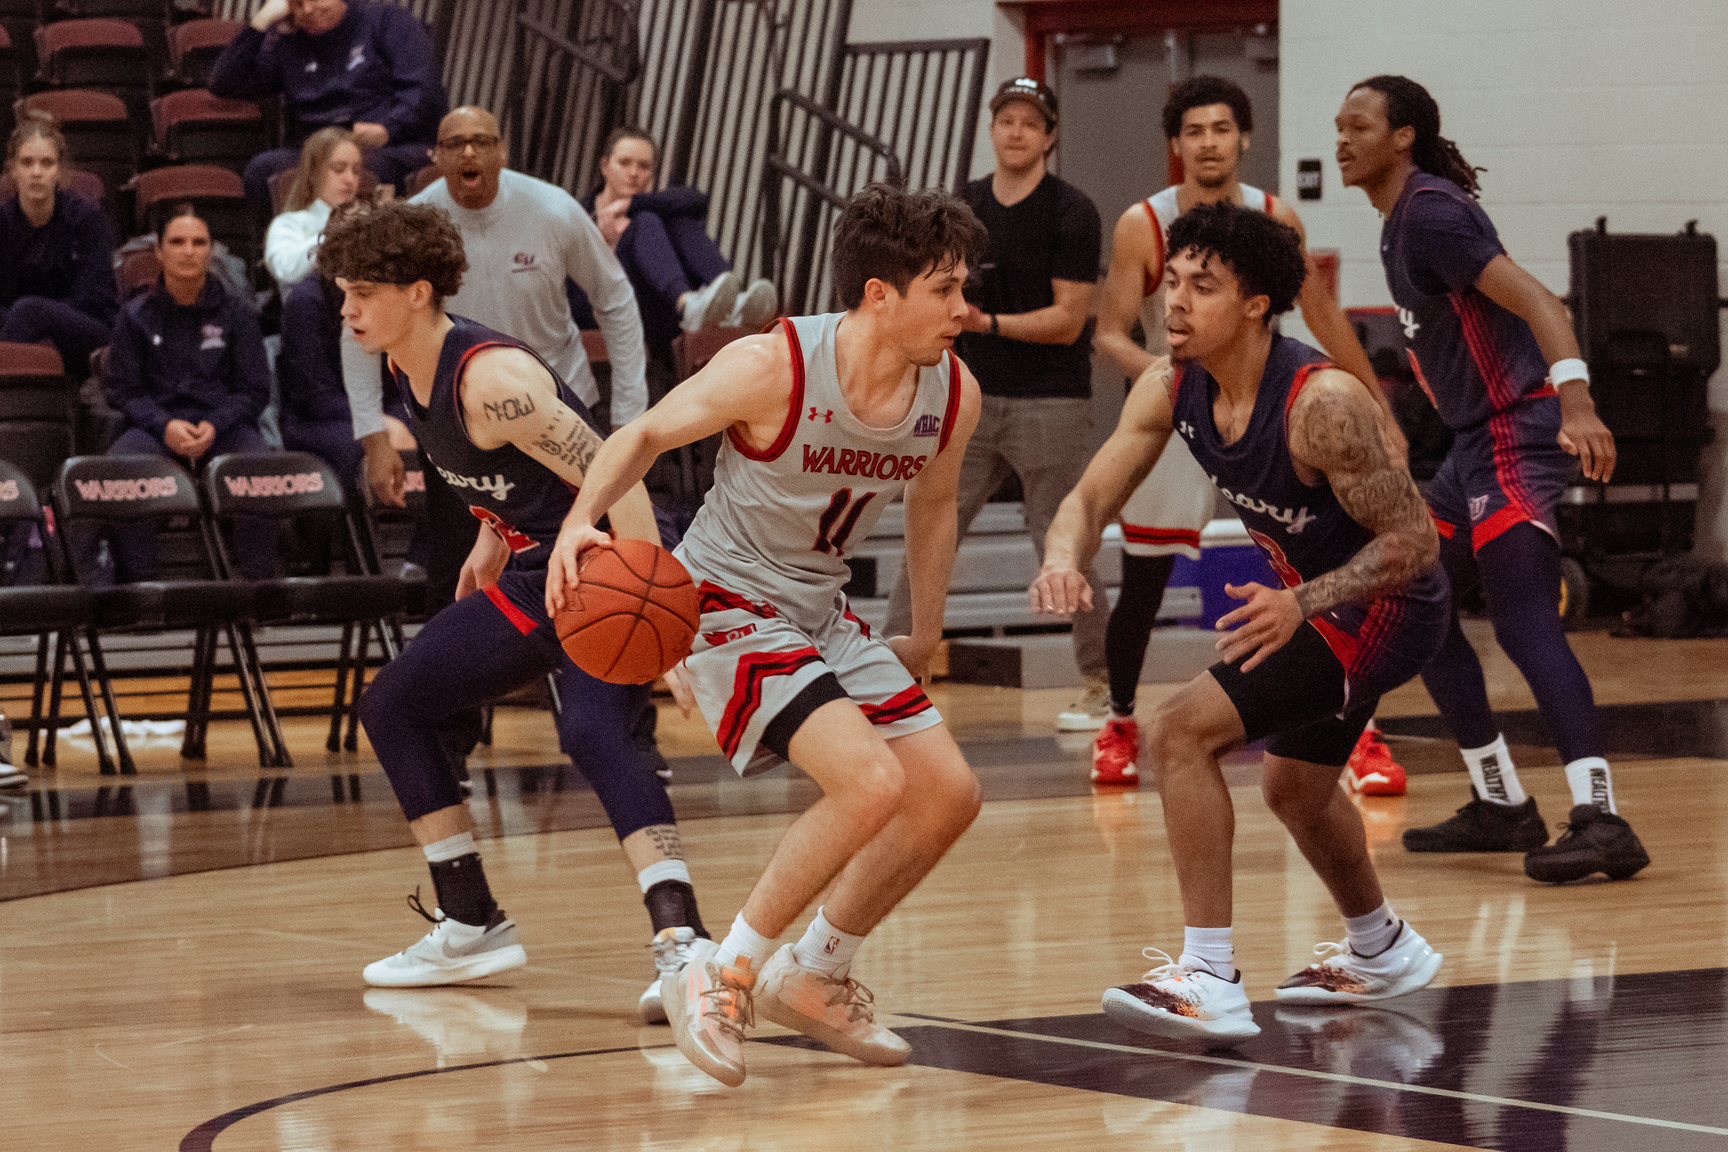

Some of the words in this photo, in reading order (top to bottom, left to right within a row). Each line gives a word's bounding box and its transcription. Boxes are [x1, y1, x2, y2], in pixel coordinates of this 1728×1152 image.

[803, 443, 927, 481] WARRIORS
[75, 475, 178, 500] WARRIORS
[224, 472, 324, 497] WARRIORS
[811, 487, 877, 557] 11
[1211, 475, 1316, 534] eary
